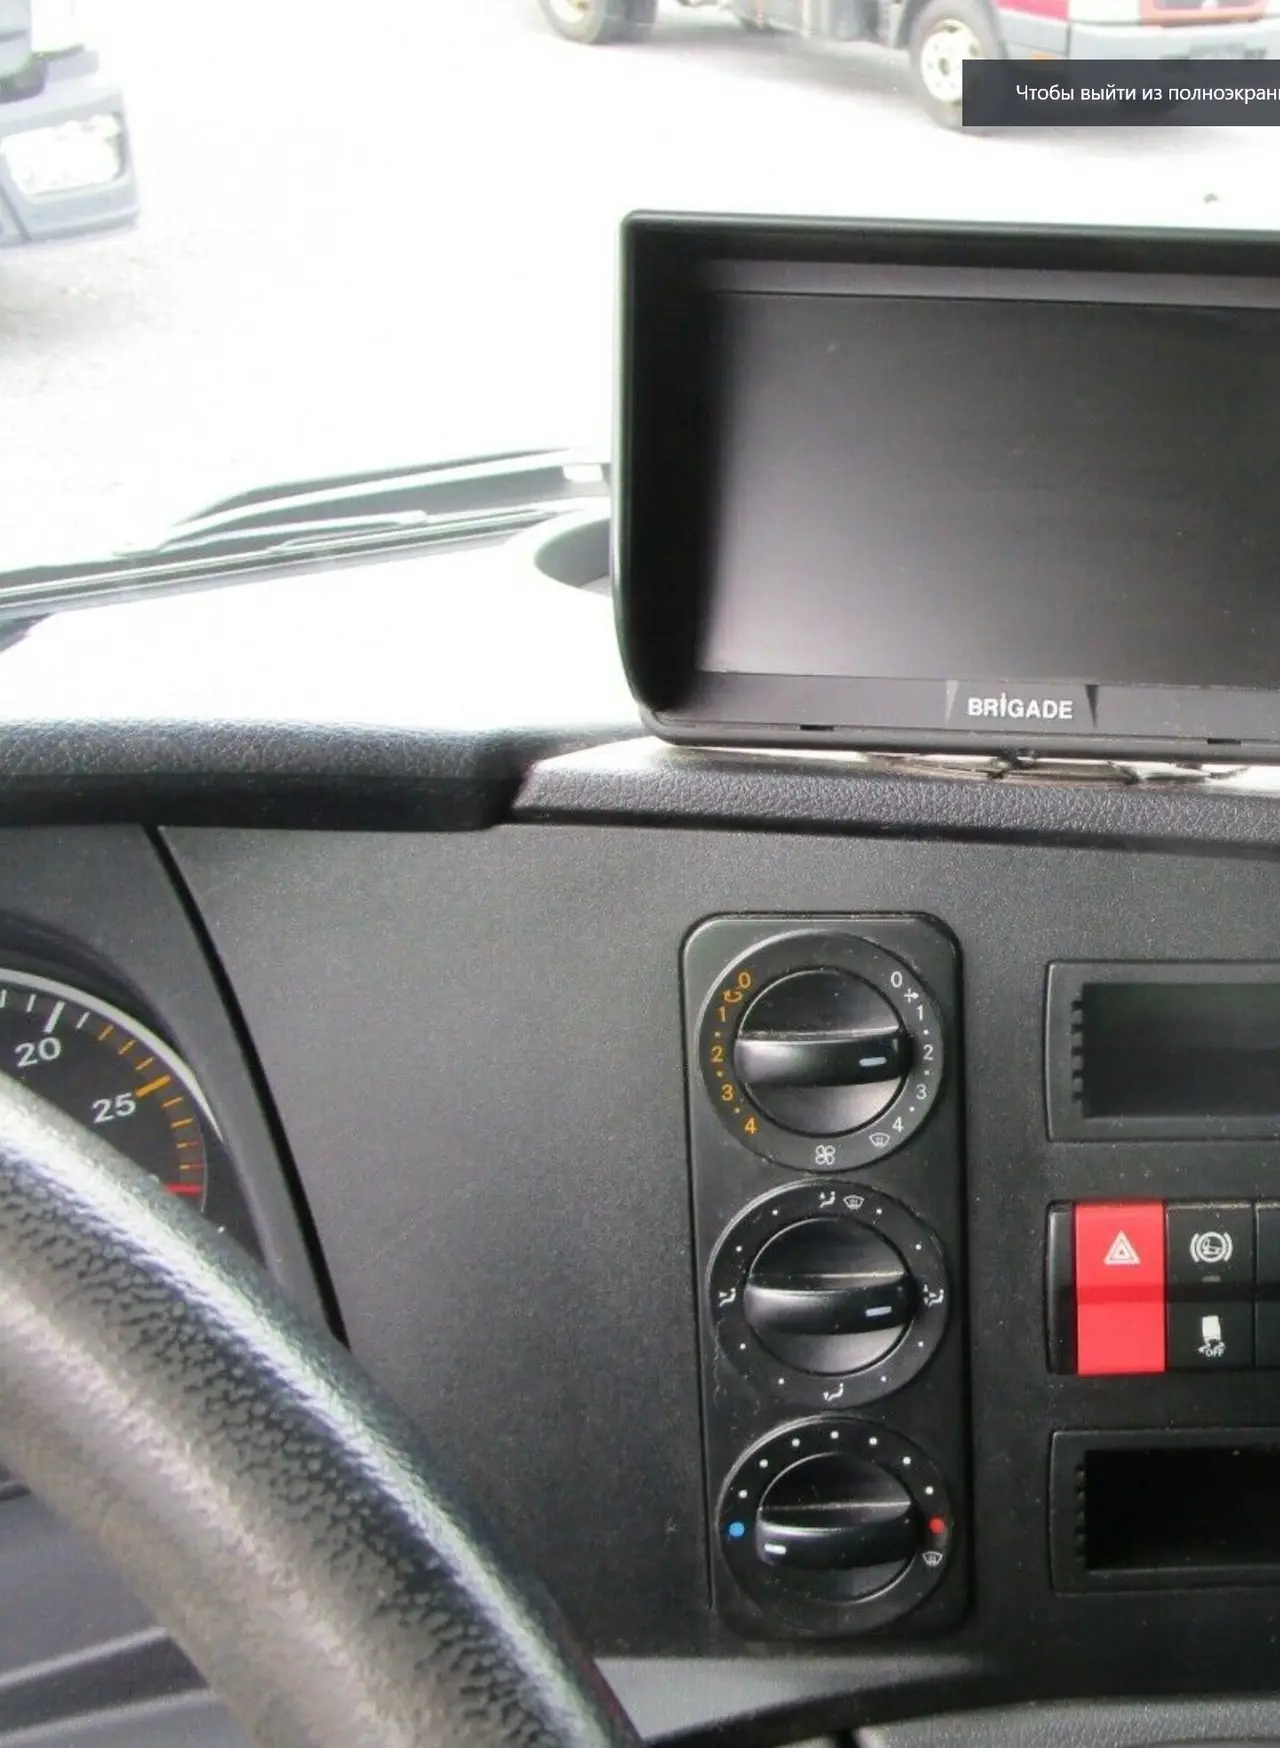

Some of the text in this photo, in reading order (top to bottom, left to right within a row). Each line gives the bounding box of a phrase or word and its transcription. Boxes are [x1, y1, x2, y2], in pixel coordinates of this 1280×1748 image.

[967, 692, 1073, 719] BRIGADE
[737, 971, 751, 989] 0
[890, 971, 903, 988] 0
[718, 1006, 727, 1022] 1
[916, 1005, 925, 1021] 1
[14, 1037, 62, 1067] 20
[712, 1046, 724, 1063] 2
[923, 1044, 934, 1061] 2
[721, 1084, 734, 1101] 3
[916, 1084, 927, 1100] 3
[91, 1091, 136, 1124] 25
[744, 1117, 758, 1135] 4
[892, 1116, 903, 1133] 4
